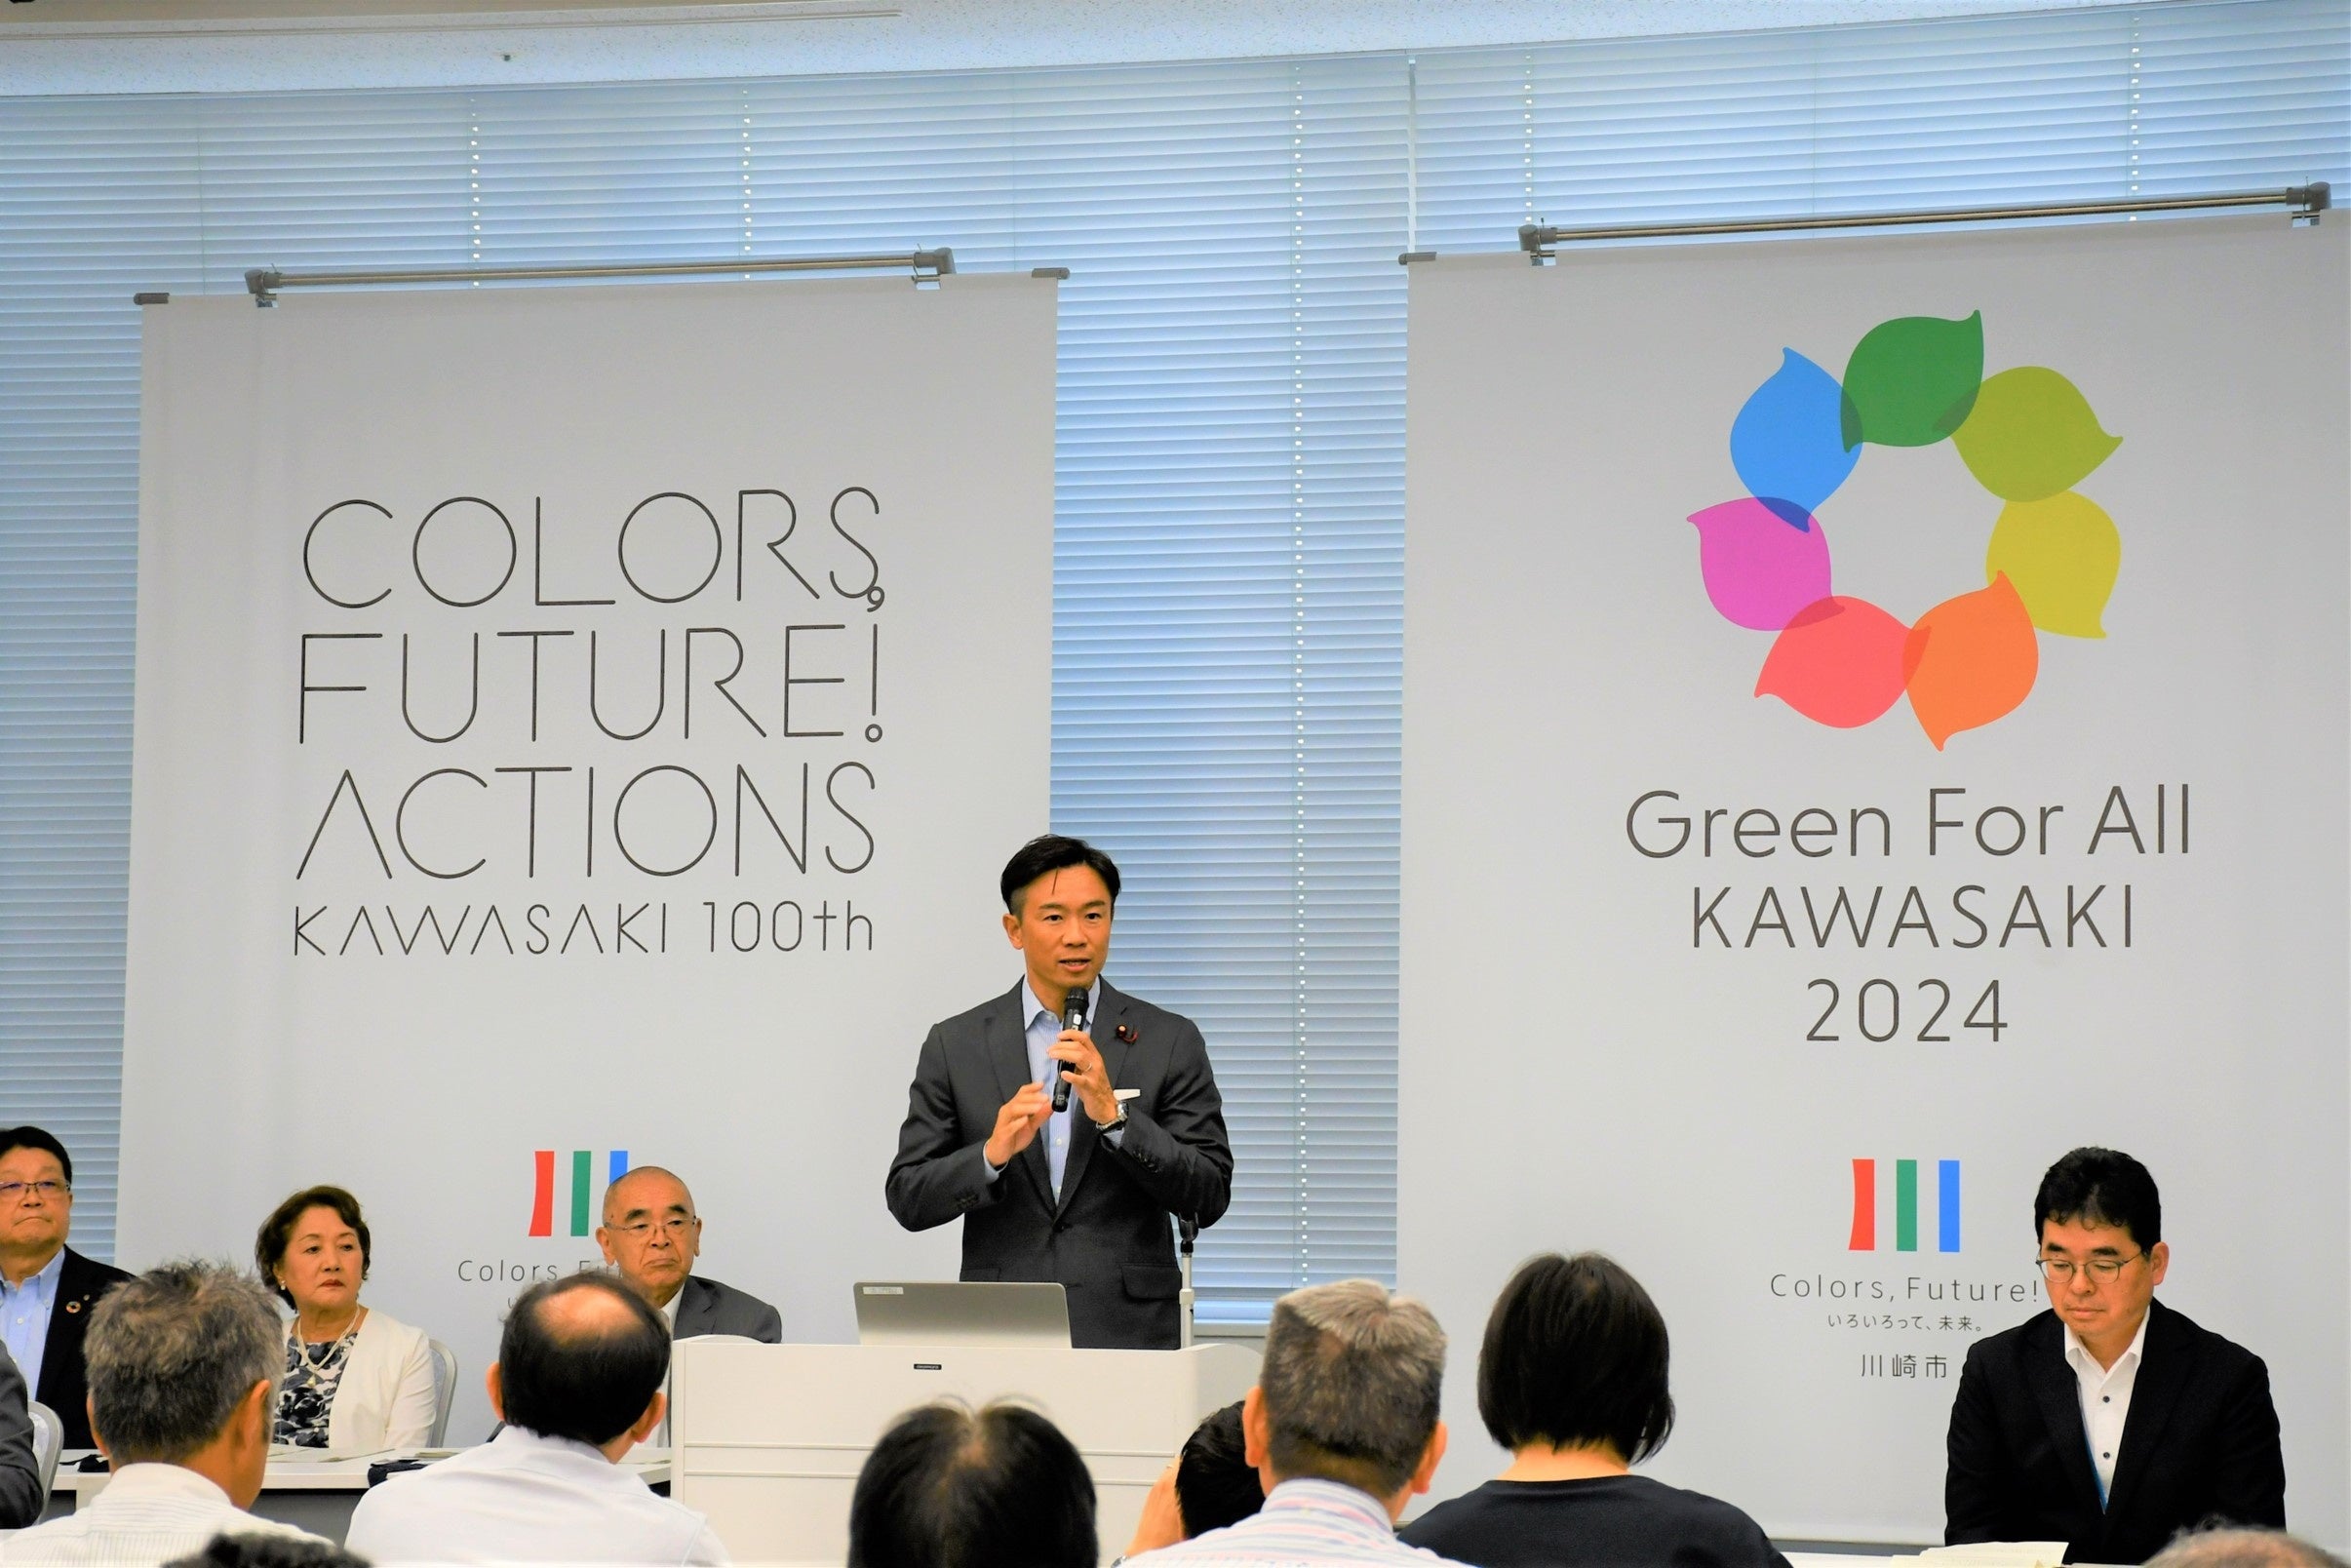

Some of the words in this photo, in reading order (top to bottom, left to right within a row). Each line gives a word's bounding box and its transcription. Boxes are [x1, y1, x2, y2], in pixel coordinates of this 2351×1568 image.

[303, 487, 884, 612] COLORS,
[299, 623, 882, 744] FUTURE!
[296, 762, 875, 880] ACTIONS
[1626, 790, 1891, 858] Green
[1929, 787, 2064, 856] For
[2087, 783, 2189, 854] All
[294, 903, 667, 957] KAWASAKI
[703, 900, 873, 954] 100th
[1693, 883, 2132, 949] KAWASAKI
[1806, 978, 2009, 1043] 2024
[1770, 1274, 1895, 1303] Colors,
[1907, 1276, 2038, 1303] Future!
[1861, 1353, 1947, 1379] 川崎市
